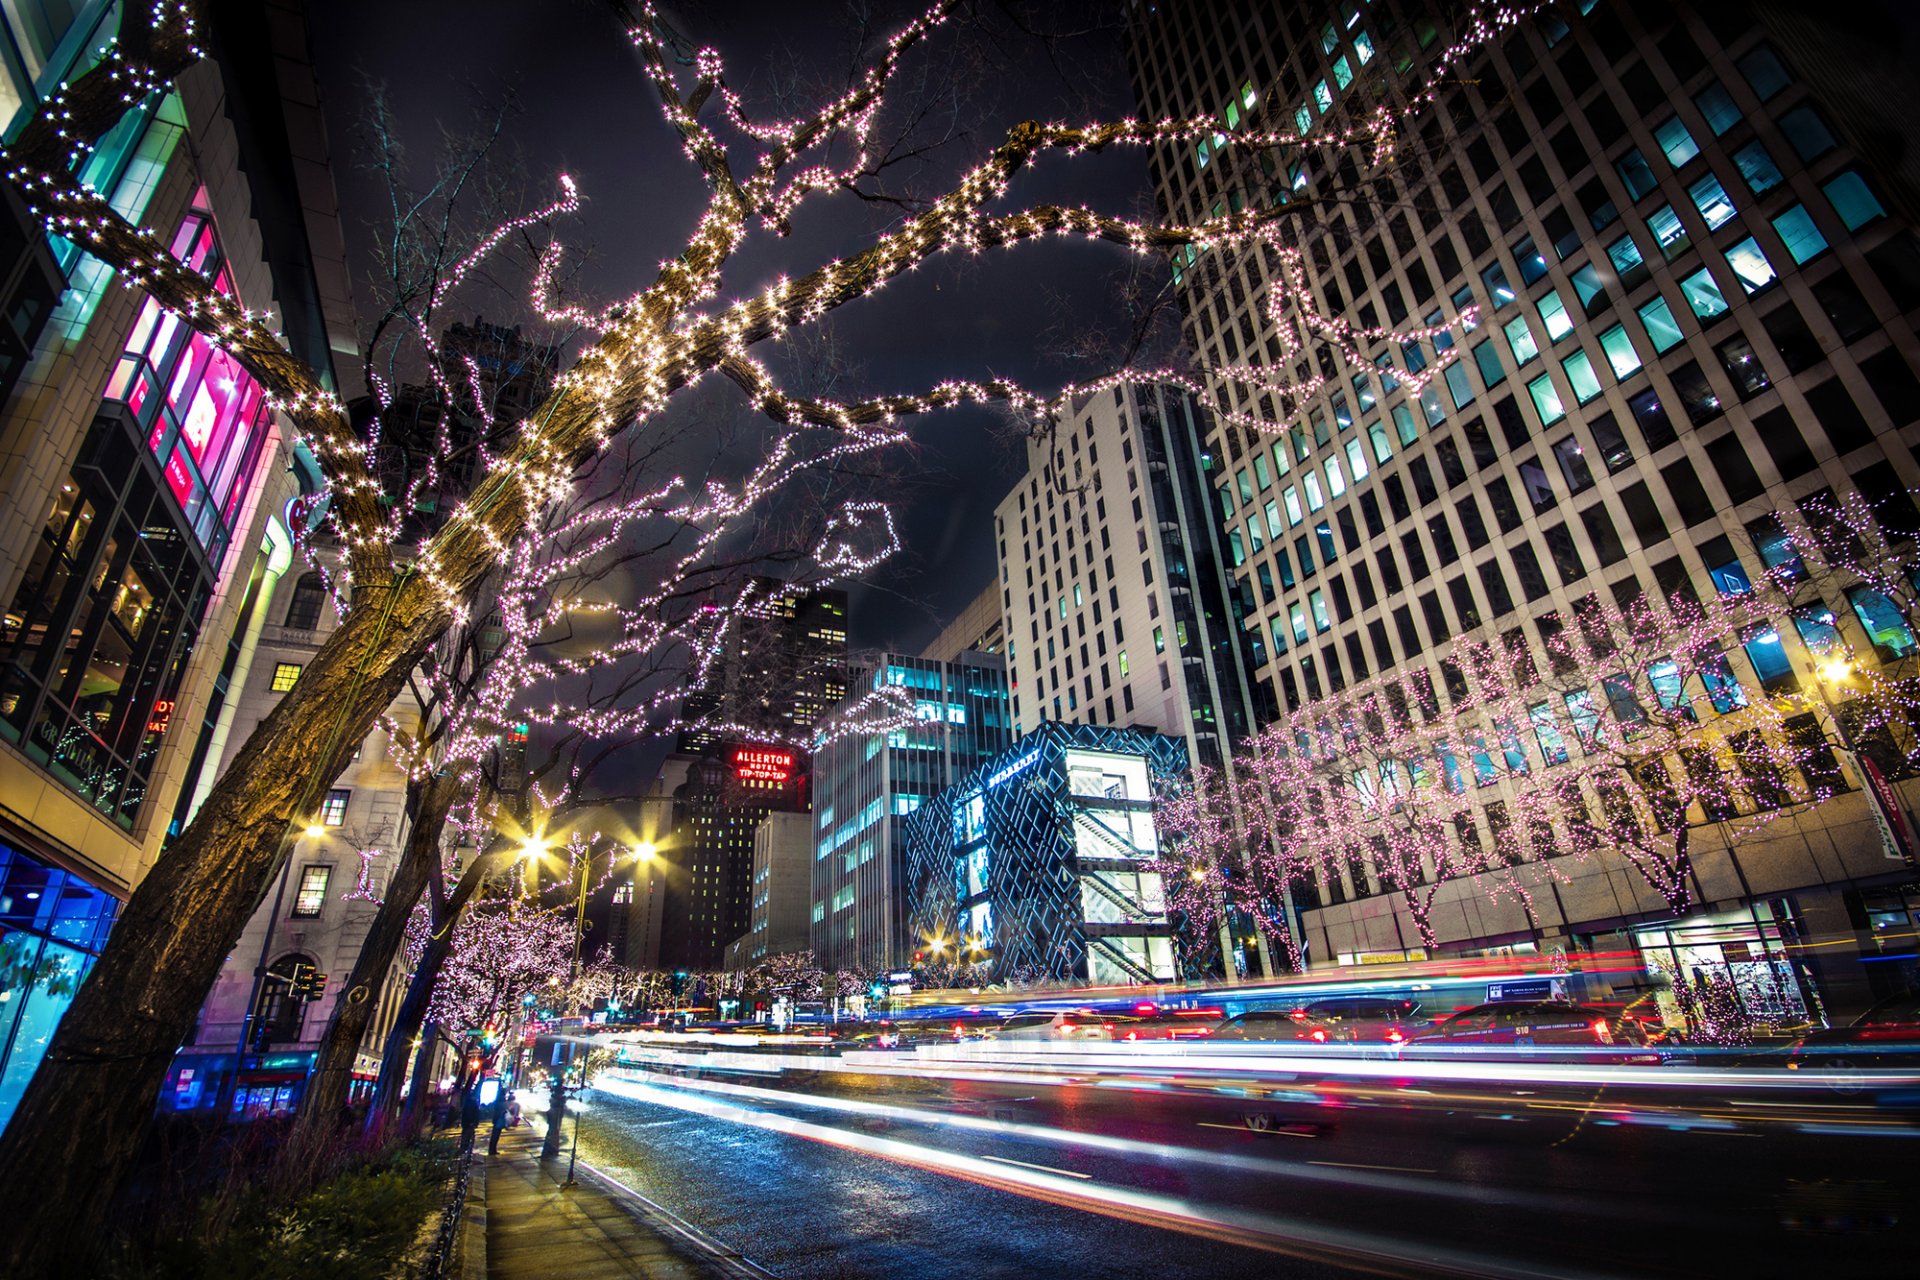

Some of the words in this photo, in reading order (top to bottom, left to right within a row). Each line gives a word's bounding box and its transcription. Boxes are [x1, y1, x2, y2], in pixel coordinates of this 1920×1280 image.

[737, 751, 791, 766] ALLERTON
[750, 763, 778, 771] HOTEL
[988, 749, 1040, 789] BURBERRY
[1878, 778, 1897, 811] shop
[1515, 1026, 1529, 1035] 510
